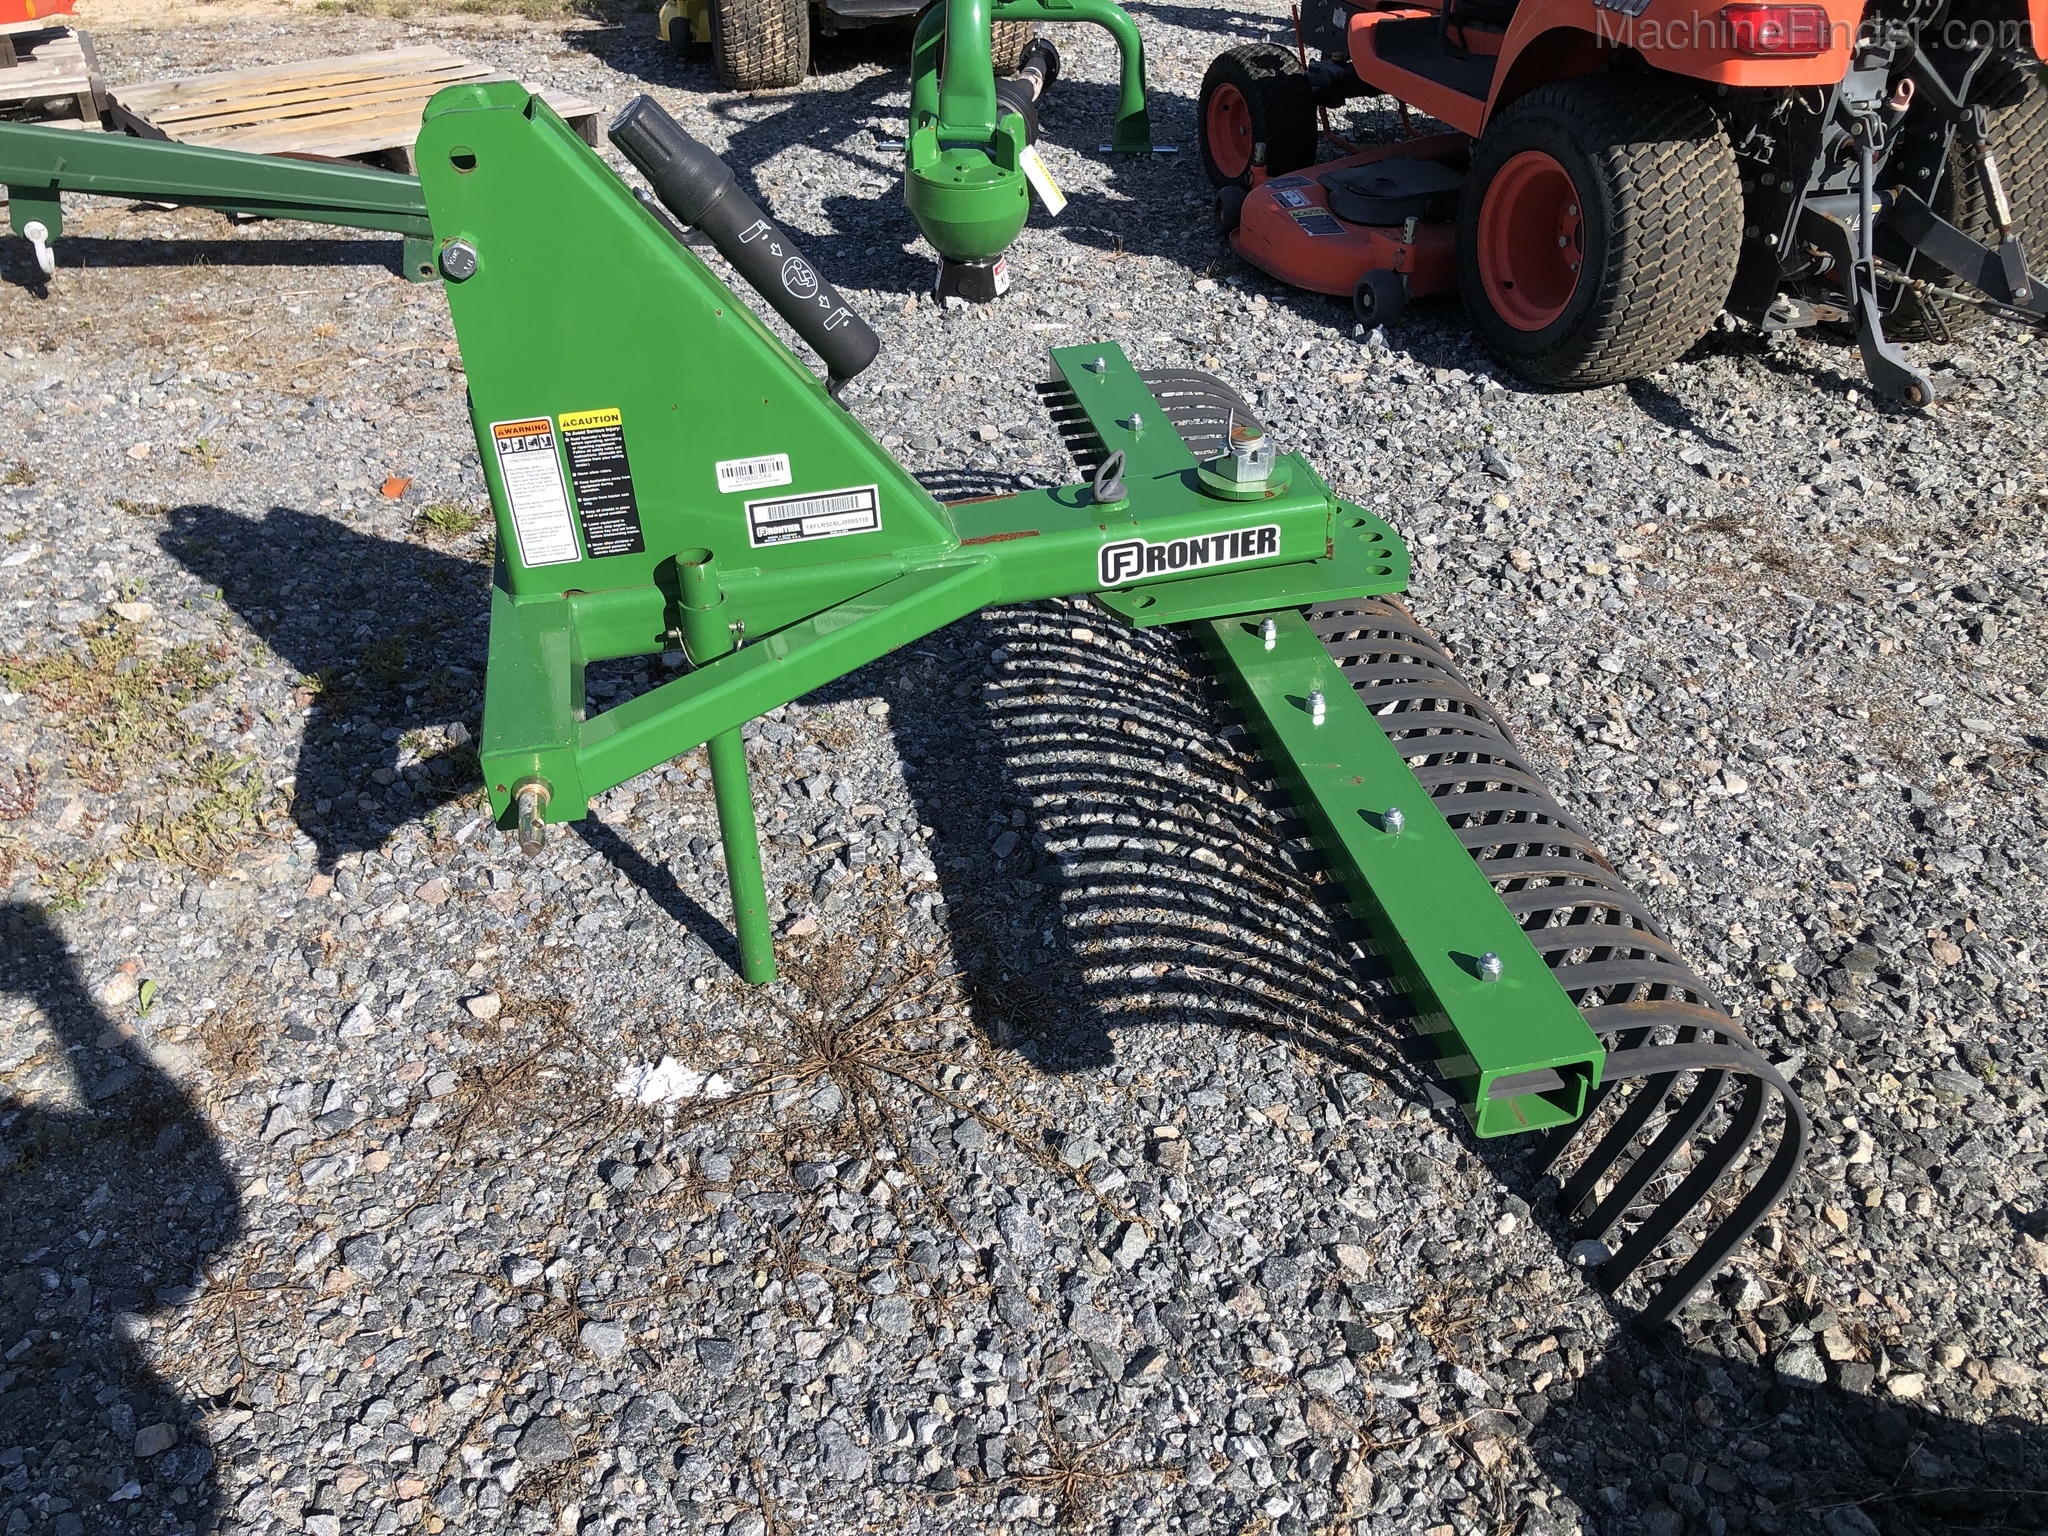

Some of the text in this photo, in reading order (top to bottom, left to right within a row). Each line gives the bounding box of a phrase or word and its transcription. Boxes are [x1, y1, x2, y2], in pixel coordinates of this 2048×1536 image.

[570, 414, 618, 426] CAUTION
[505, 424, 547, 434] WARNING
[756, 524, 801, 538] FRONTIER
[1101, 527, 1277, 583] FRONTIER
